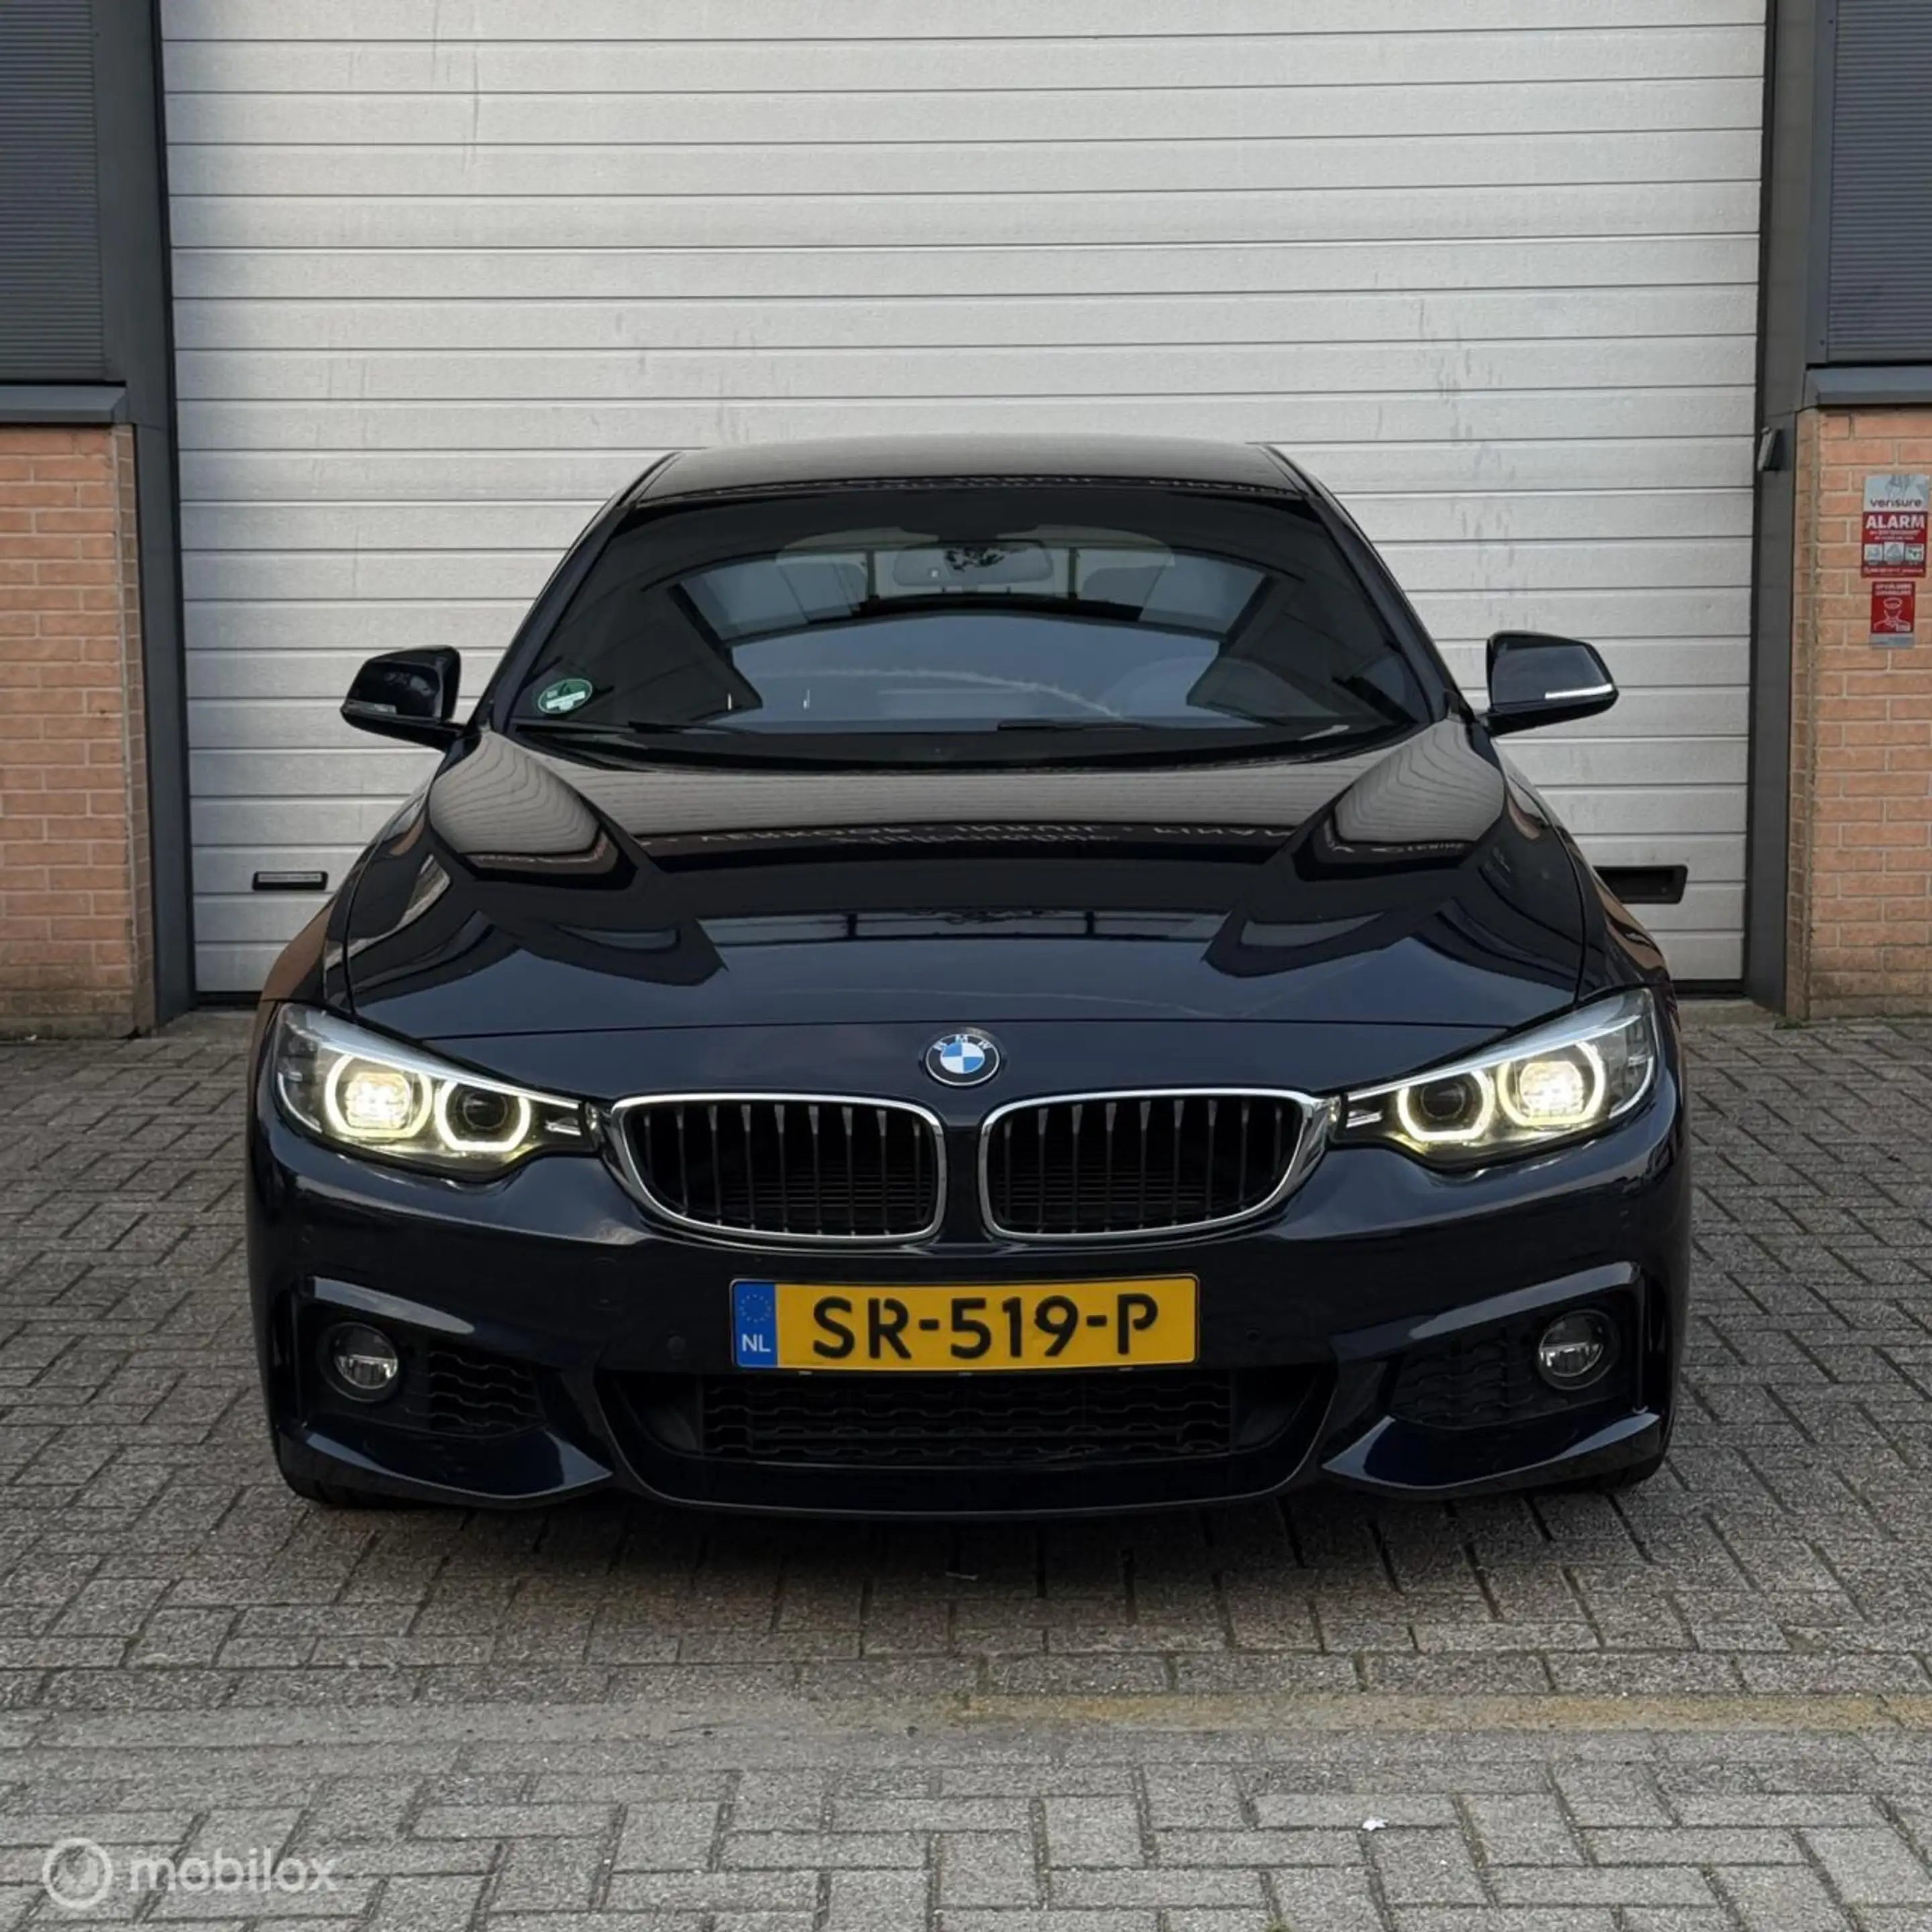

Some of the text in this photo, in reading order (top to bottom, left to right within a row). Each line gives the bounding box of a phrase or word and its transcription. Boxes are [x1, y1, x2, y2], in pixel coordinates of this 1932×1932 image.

[1870, 498, 1922, 508] verisure
[1866, 515, 1925, 529] ALARM
[932, 1034, 993, 1051] BMW
[812, 1293, 1159, 1359] SR-519-P
[741, 1334, 771, 1353] NL
